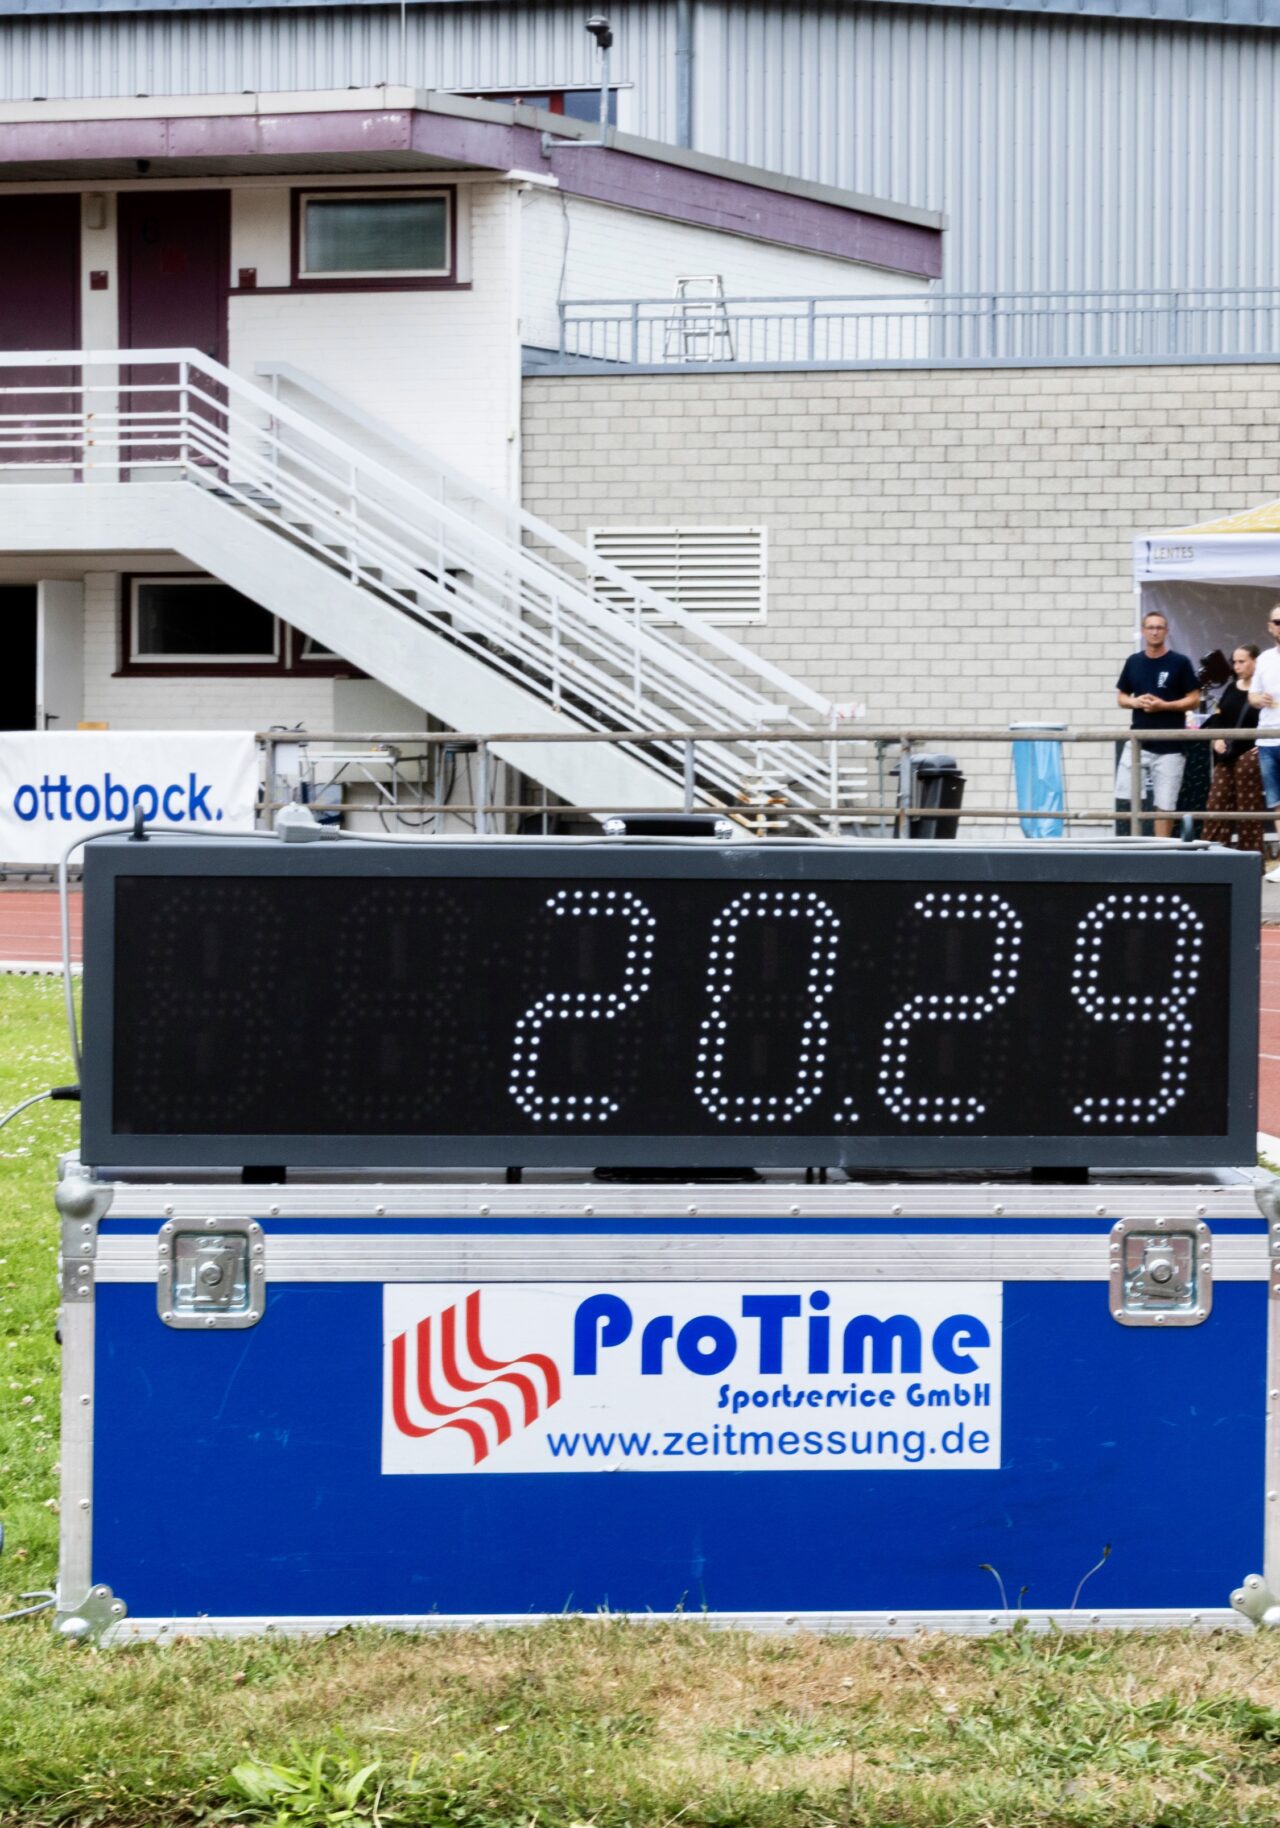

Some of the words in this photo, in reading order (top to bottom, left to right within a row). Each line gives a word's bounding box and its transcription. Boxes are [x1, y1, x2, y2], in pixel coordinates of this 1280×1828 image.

[1153, 546, 1195, 560] LENTES
[13, 772, 223, 822] ottobock.
[508, 891, 1203, 1123] 20.29
[573, 1290, 991, 1376] ProTime
[717, 1383, 896, 1414] Sportservice
[906, 1383, 991, 1407] GmbH
[547, 1422, 991, 1463] www.zeitmessung.de
